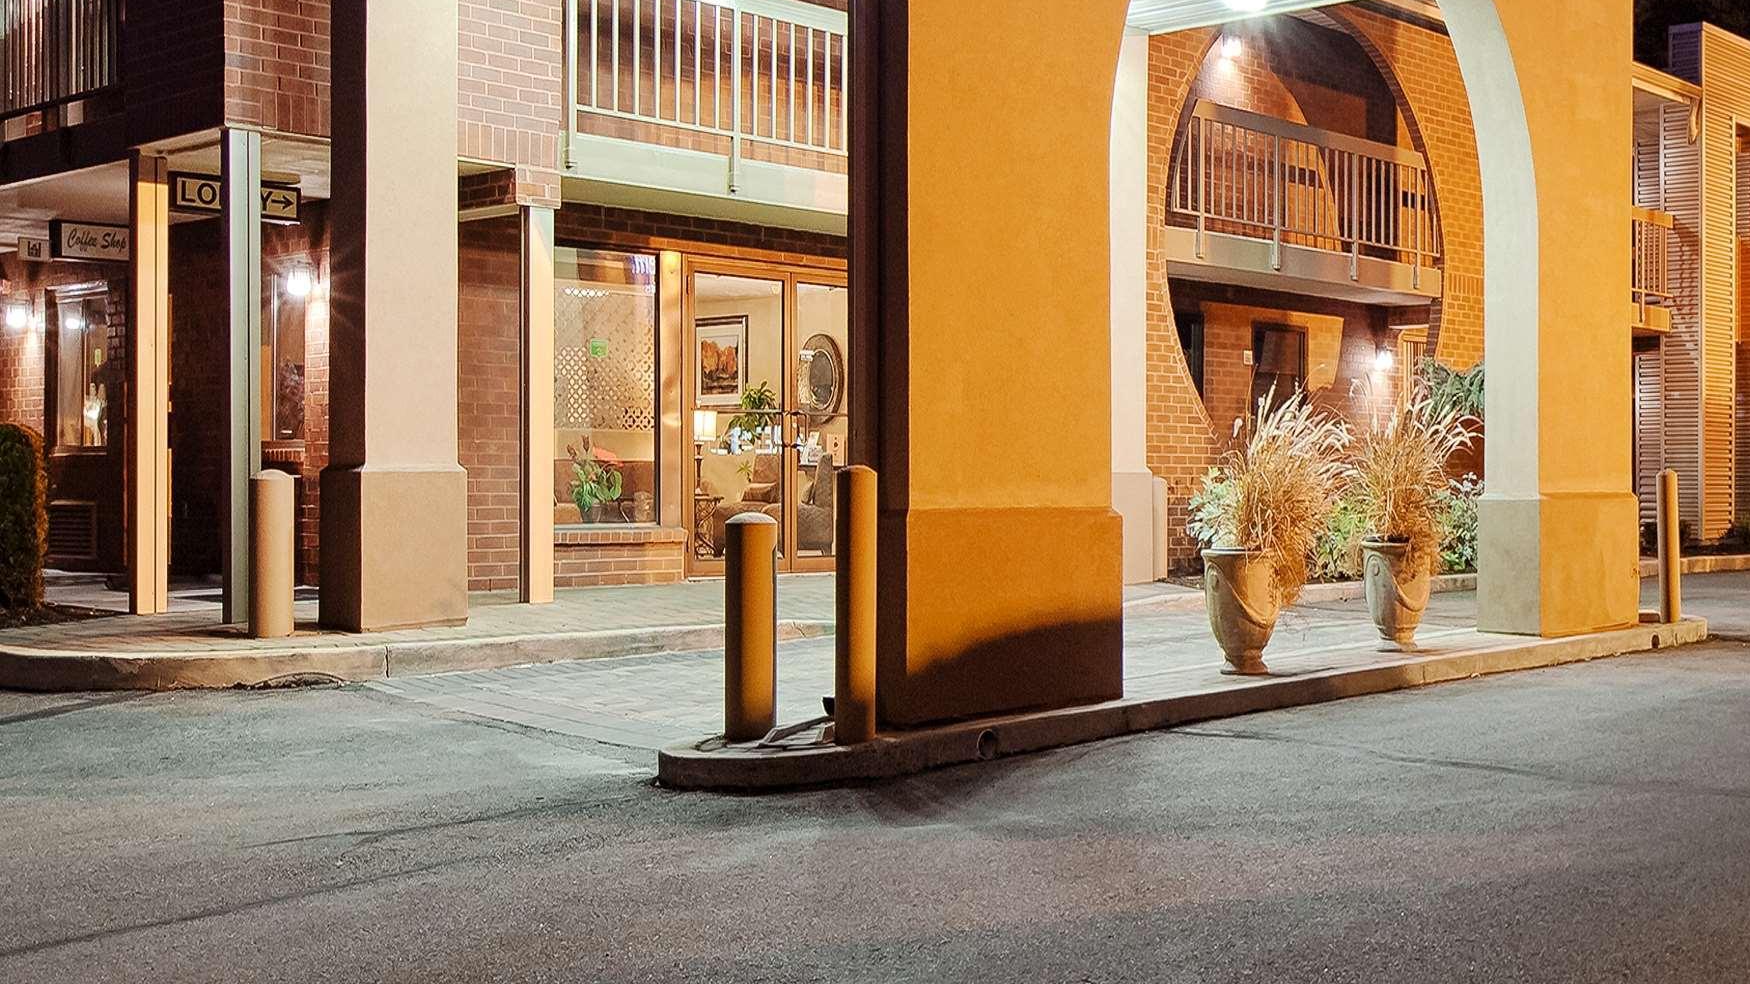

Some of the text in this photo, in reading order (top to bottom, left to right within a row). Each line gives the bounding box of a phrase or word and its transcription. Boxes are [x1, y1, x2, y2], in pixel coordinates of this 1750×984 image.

[182, 180, 273, 211] LOY
[67, 228, 127, 252] Coffee Shop
